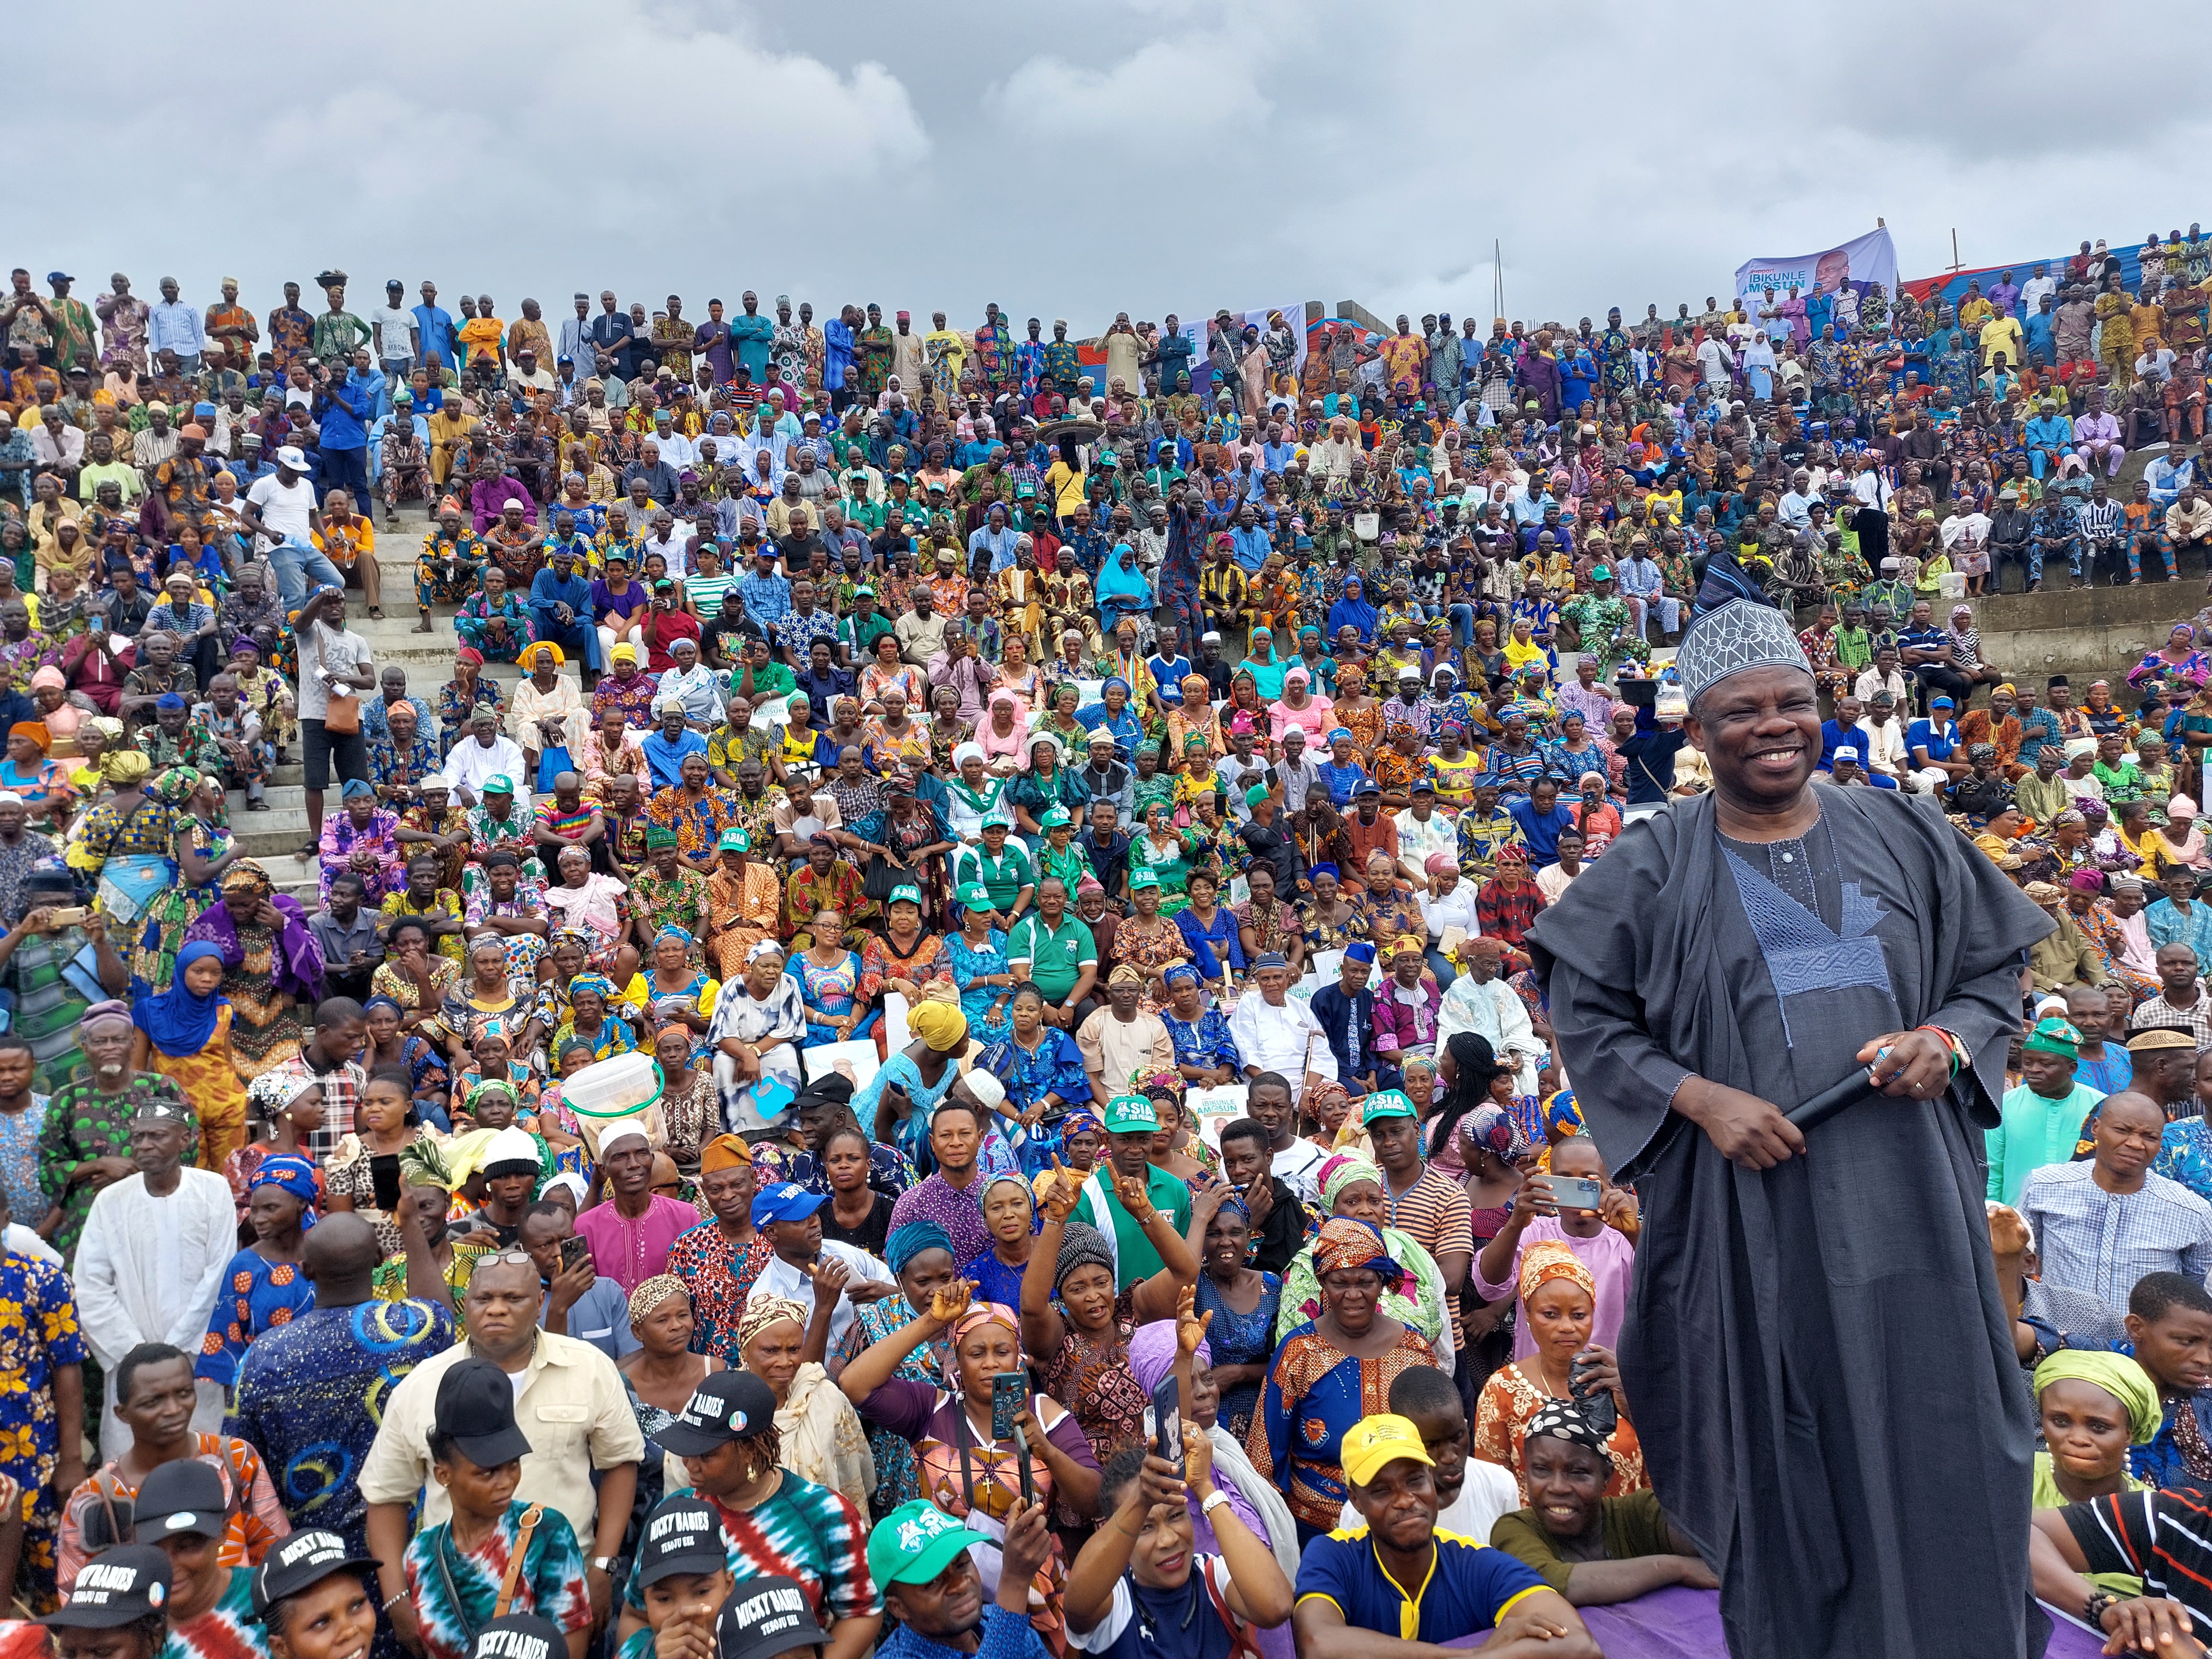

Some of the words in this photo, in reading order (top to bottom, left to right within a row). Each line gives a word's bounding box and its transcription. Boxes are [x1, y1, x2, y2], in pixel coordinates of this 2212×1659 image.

[1749, 270, 1806, 283] IBIKUNLE
[1434, 572, 1446, 584] 33
[753, 708, 784, 717] AMOSUN
[491, 775, 505, 785] SIA
[730, 832, 745, 842] SIA
[1143, 871, 1156, 879] SIA
[1376, 1094, 1404, 1105] SIA
[1130, 1102, 1154, 1117] SIA
[1197, 1105, 1237, 1114] AMOSUN
[1383, 1104, 1407, 1112] PRESIDENT
[694, 1394, 725, 1418] BABIES
[693, 1416, 702, 1427] EEE
[650, 1513, 675, 1543] MICKY
[675, 1511, 709, 1532] BABIES
[280, 1532, 318, 1567] MICKY
[661, 1537, 683, 1554] TESOJU
[682, 1535, 695, 1548] EEE
[309, 1550, 335, 1566] TESOJU
[89, 1565, 137, 1592] BABIES
[734, 1591, 770, 1630] MICKY
[769, 1588, 804, 1613] BABIES
[760, 1615, 787, 1637] TESOJU
[786, 1614, 800, 1626] EEE
[475, 1630, 510, 1659] MICKY
[504, 1631, 549, 1659] BABIES
